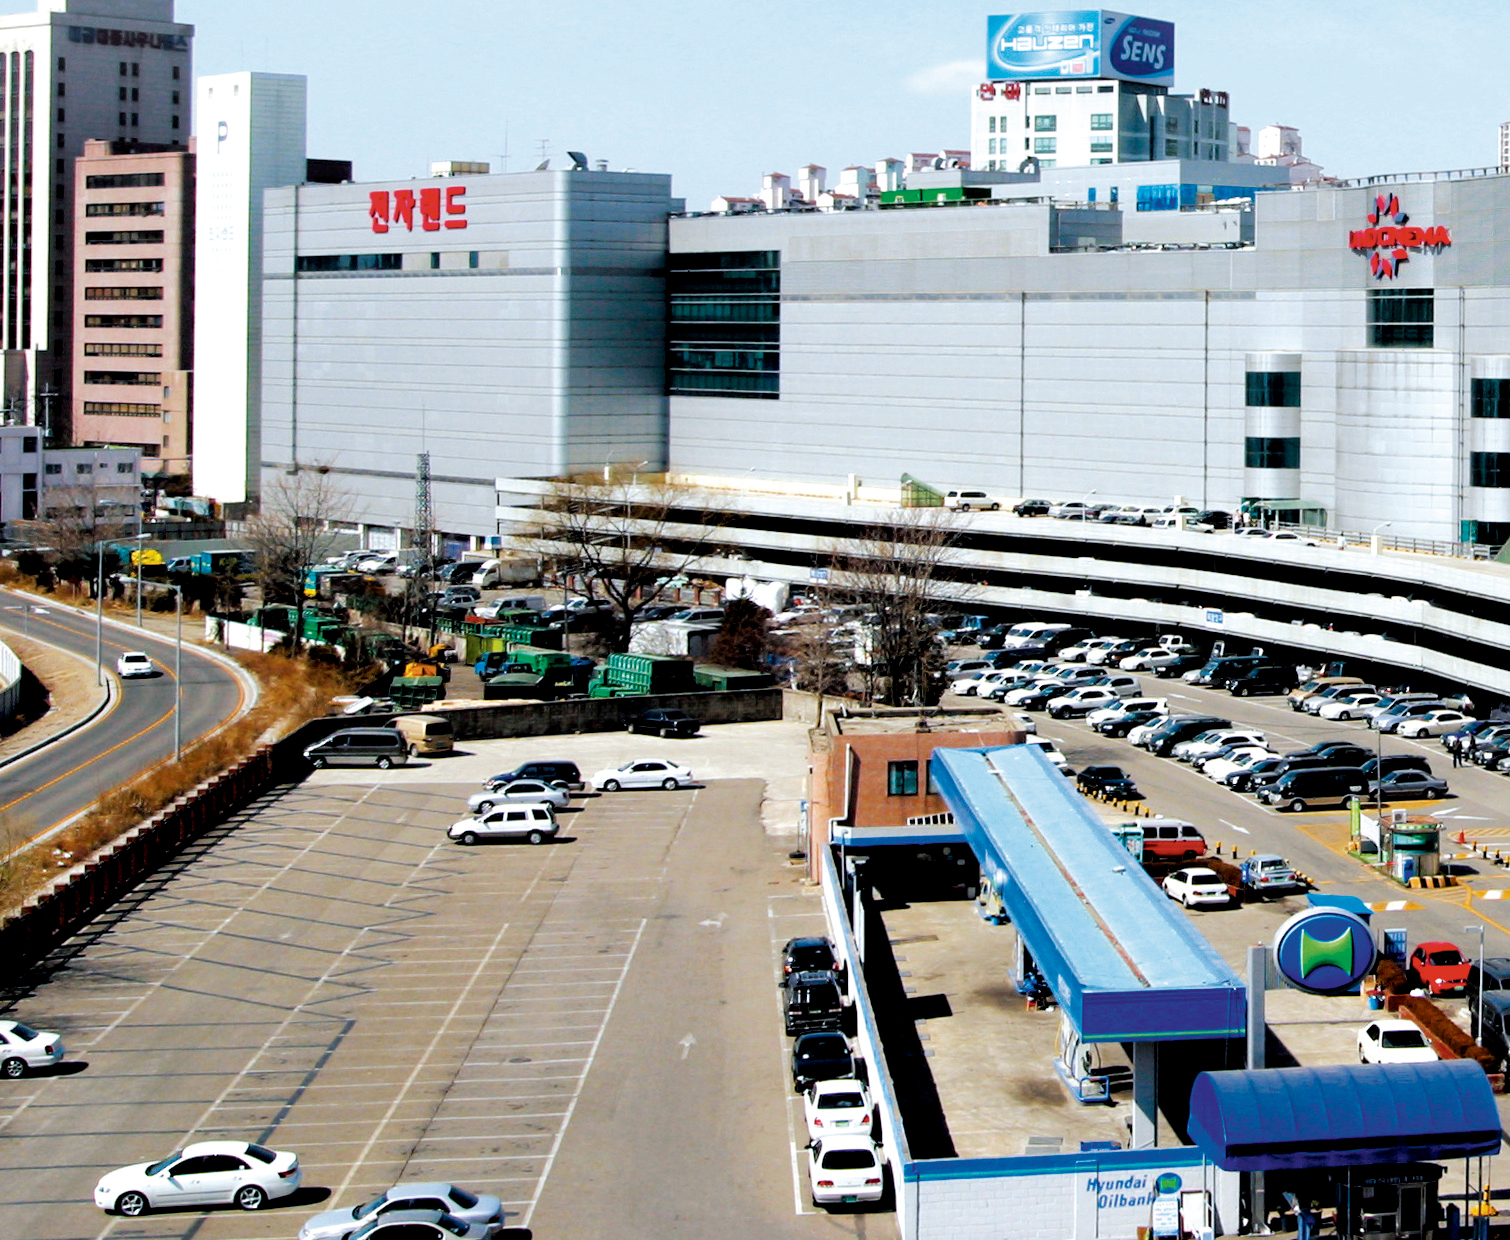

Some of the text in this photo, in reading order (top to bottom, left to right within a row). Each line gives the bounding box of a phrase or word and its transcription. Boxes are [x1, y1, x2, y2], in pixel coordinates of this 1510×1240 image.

[1120, 34, 1166, 70] SENS
[369, 186, 467, 233] 전자랜드
[1087, 1174, 1148, 1192] Hyundai
